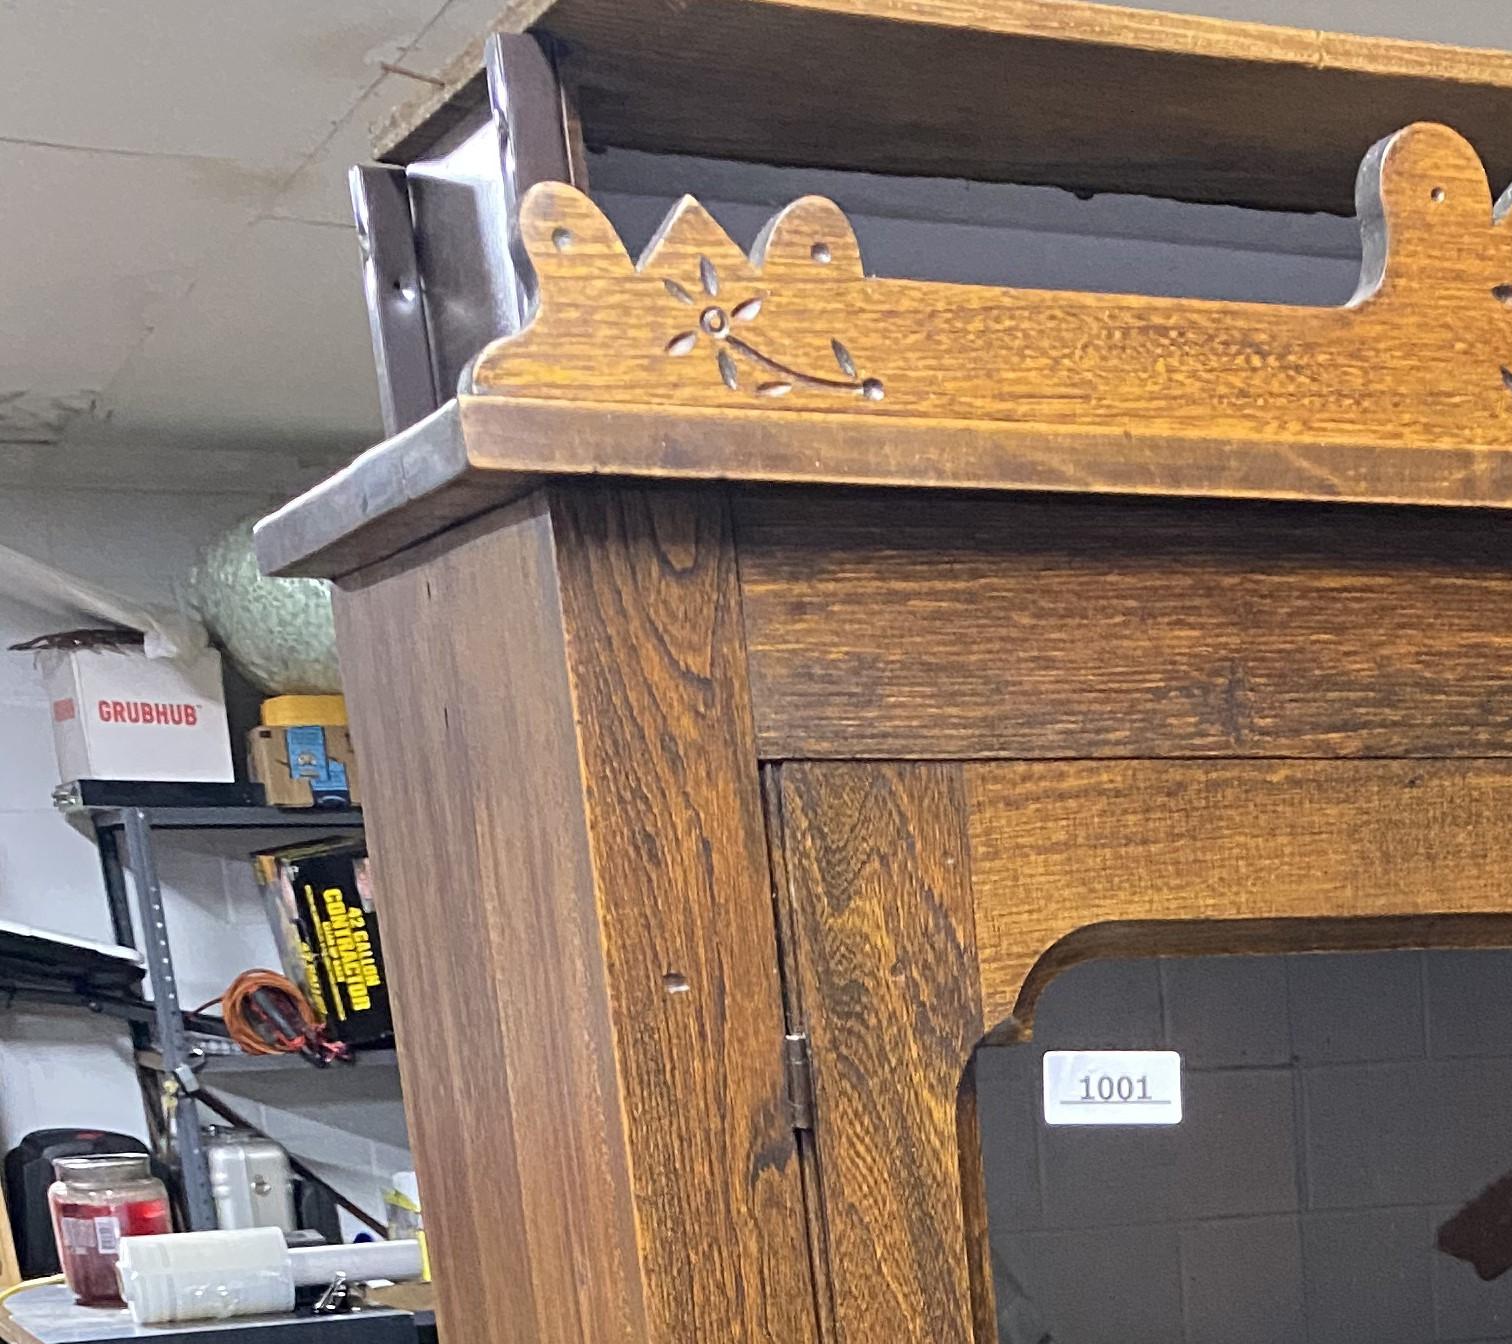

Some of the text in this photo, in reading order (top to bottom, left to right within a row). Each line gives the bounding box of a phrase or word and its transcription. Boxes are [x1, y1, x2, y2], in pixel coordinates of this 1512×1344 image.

[98, 700, 198, 726] GRUBHUB
[348, 907, 365, 928] 42
[323, 888, 371, 1012] CONTRACTOR
[1080, 1075, 1153, 1101] 1001
